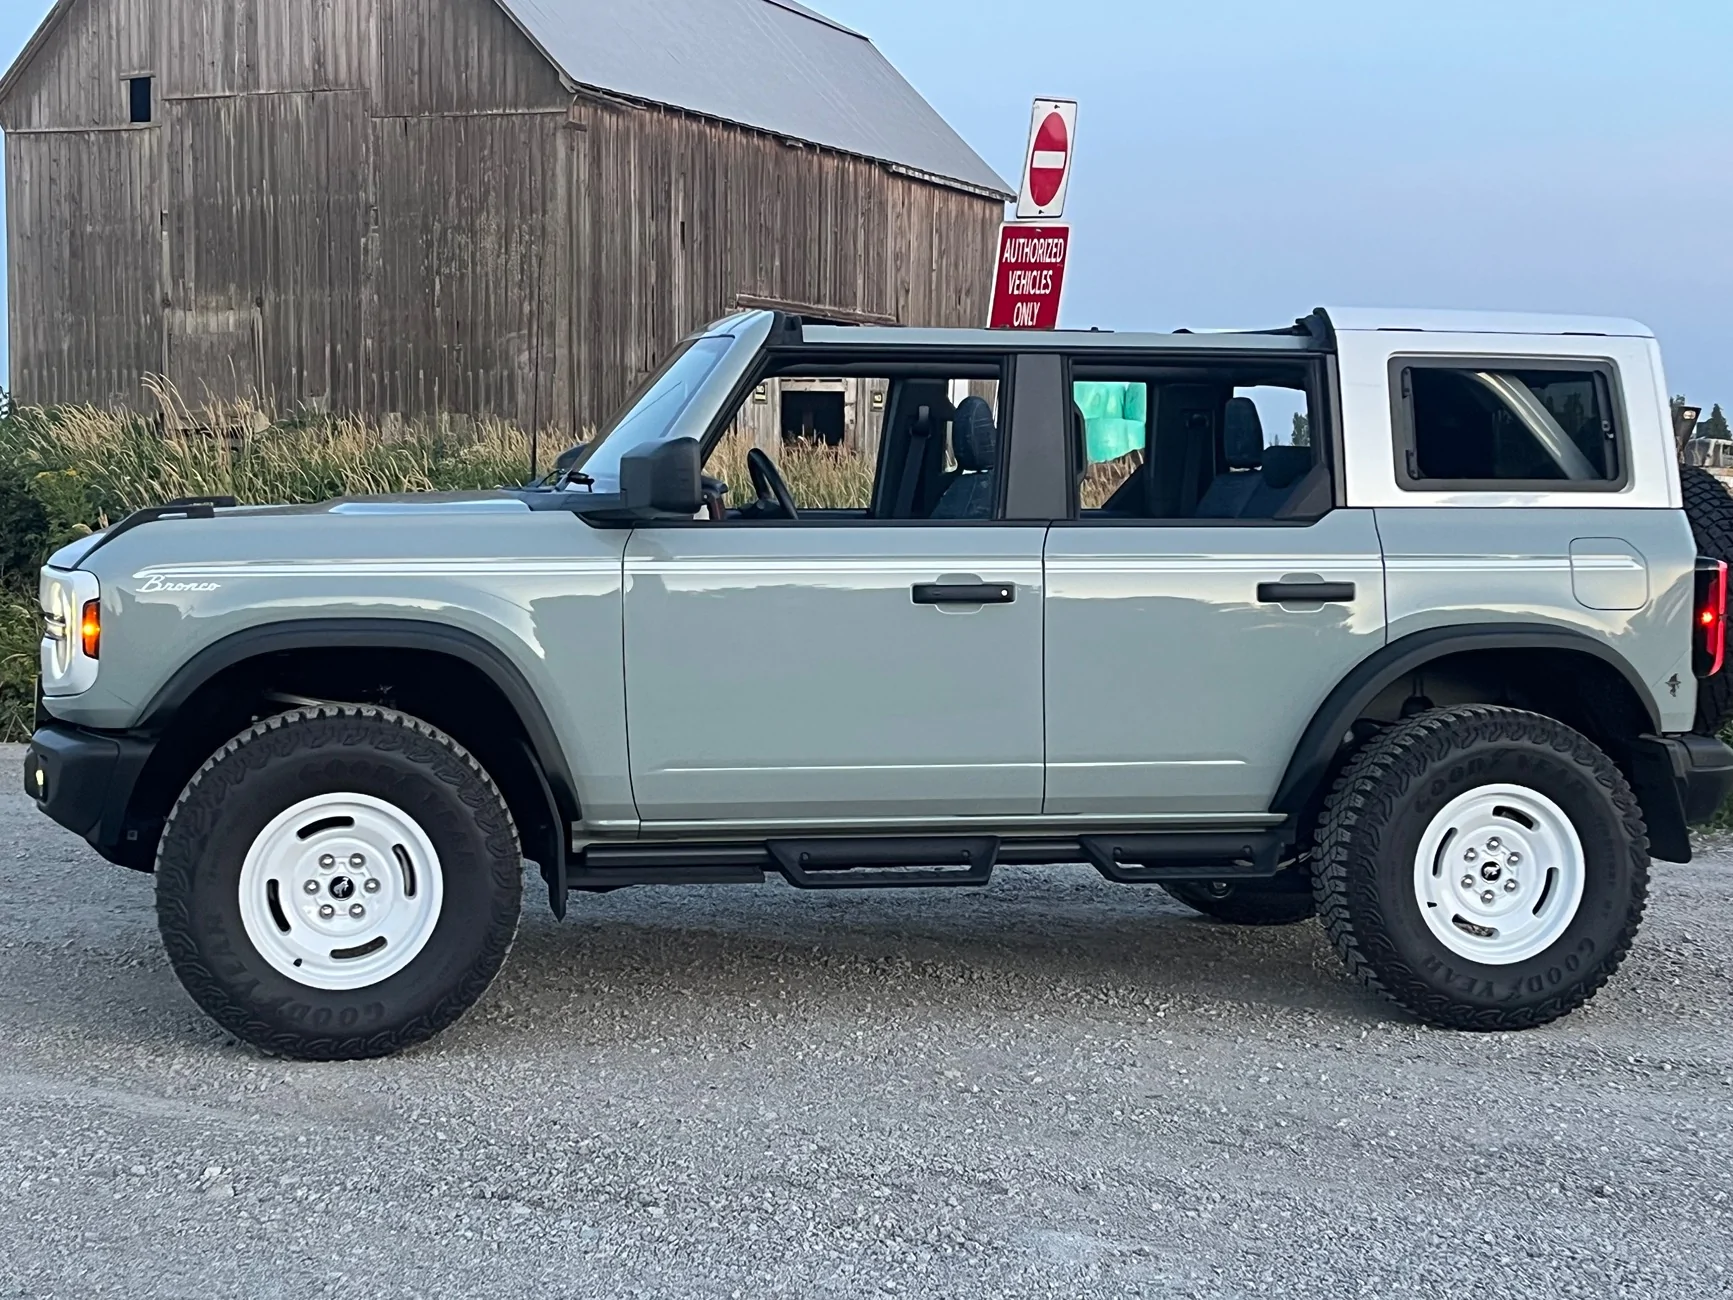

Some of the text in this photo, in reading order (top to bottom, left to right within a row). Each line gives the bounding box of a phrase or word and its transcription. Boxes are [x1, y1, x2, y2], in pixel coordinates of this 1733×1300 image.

[1002, 237, 1065, 263] AUTHORIZED
[1008, 270, 1053, 295] VEHICLES
[1013, 302, 1041, 327] ONLY
[135, 574, 222, 593] Bronco
